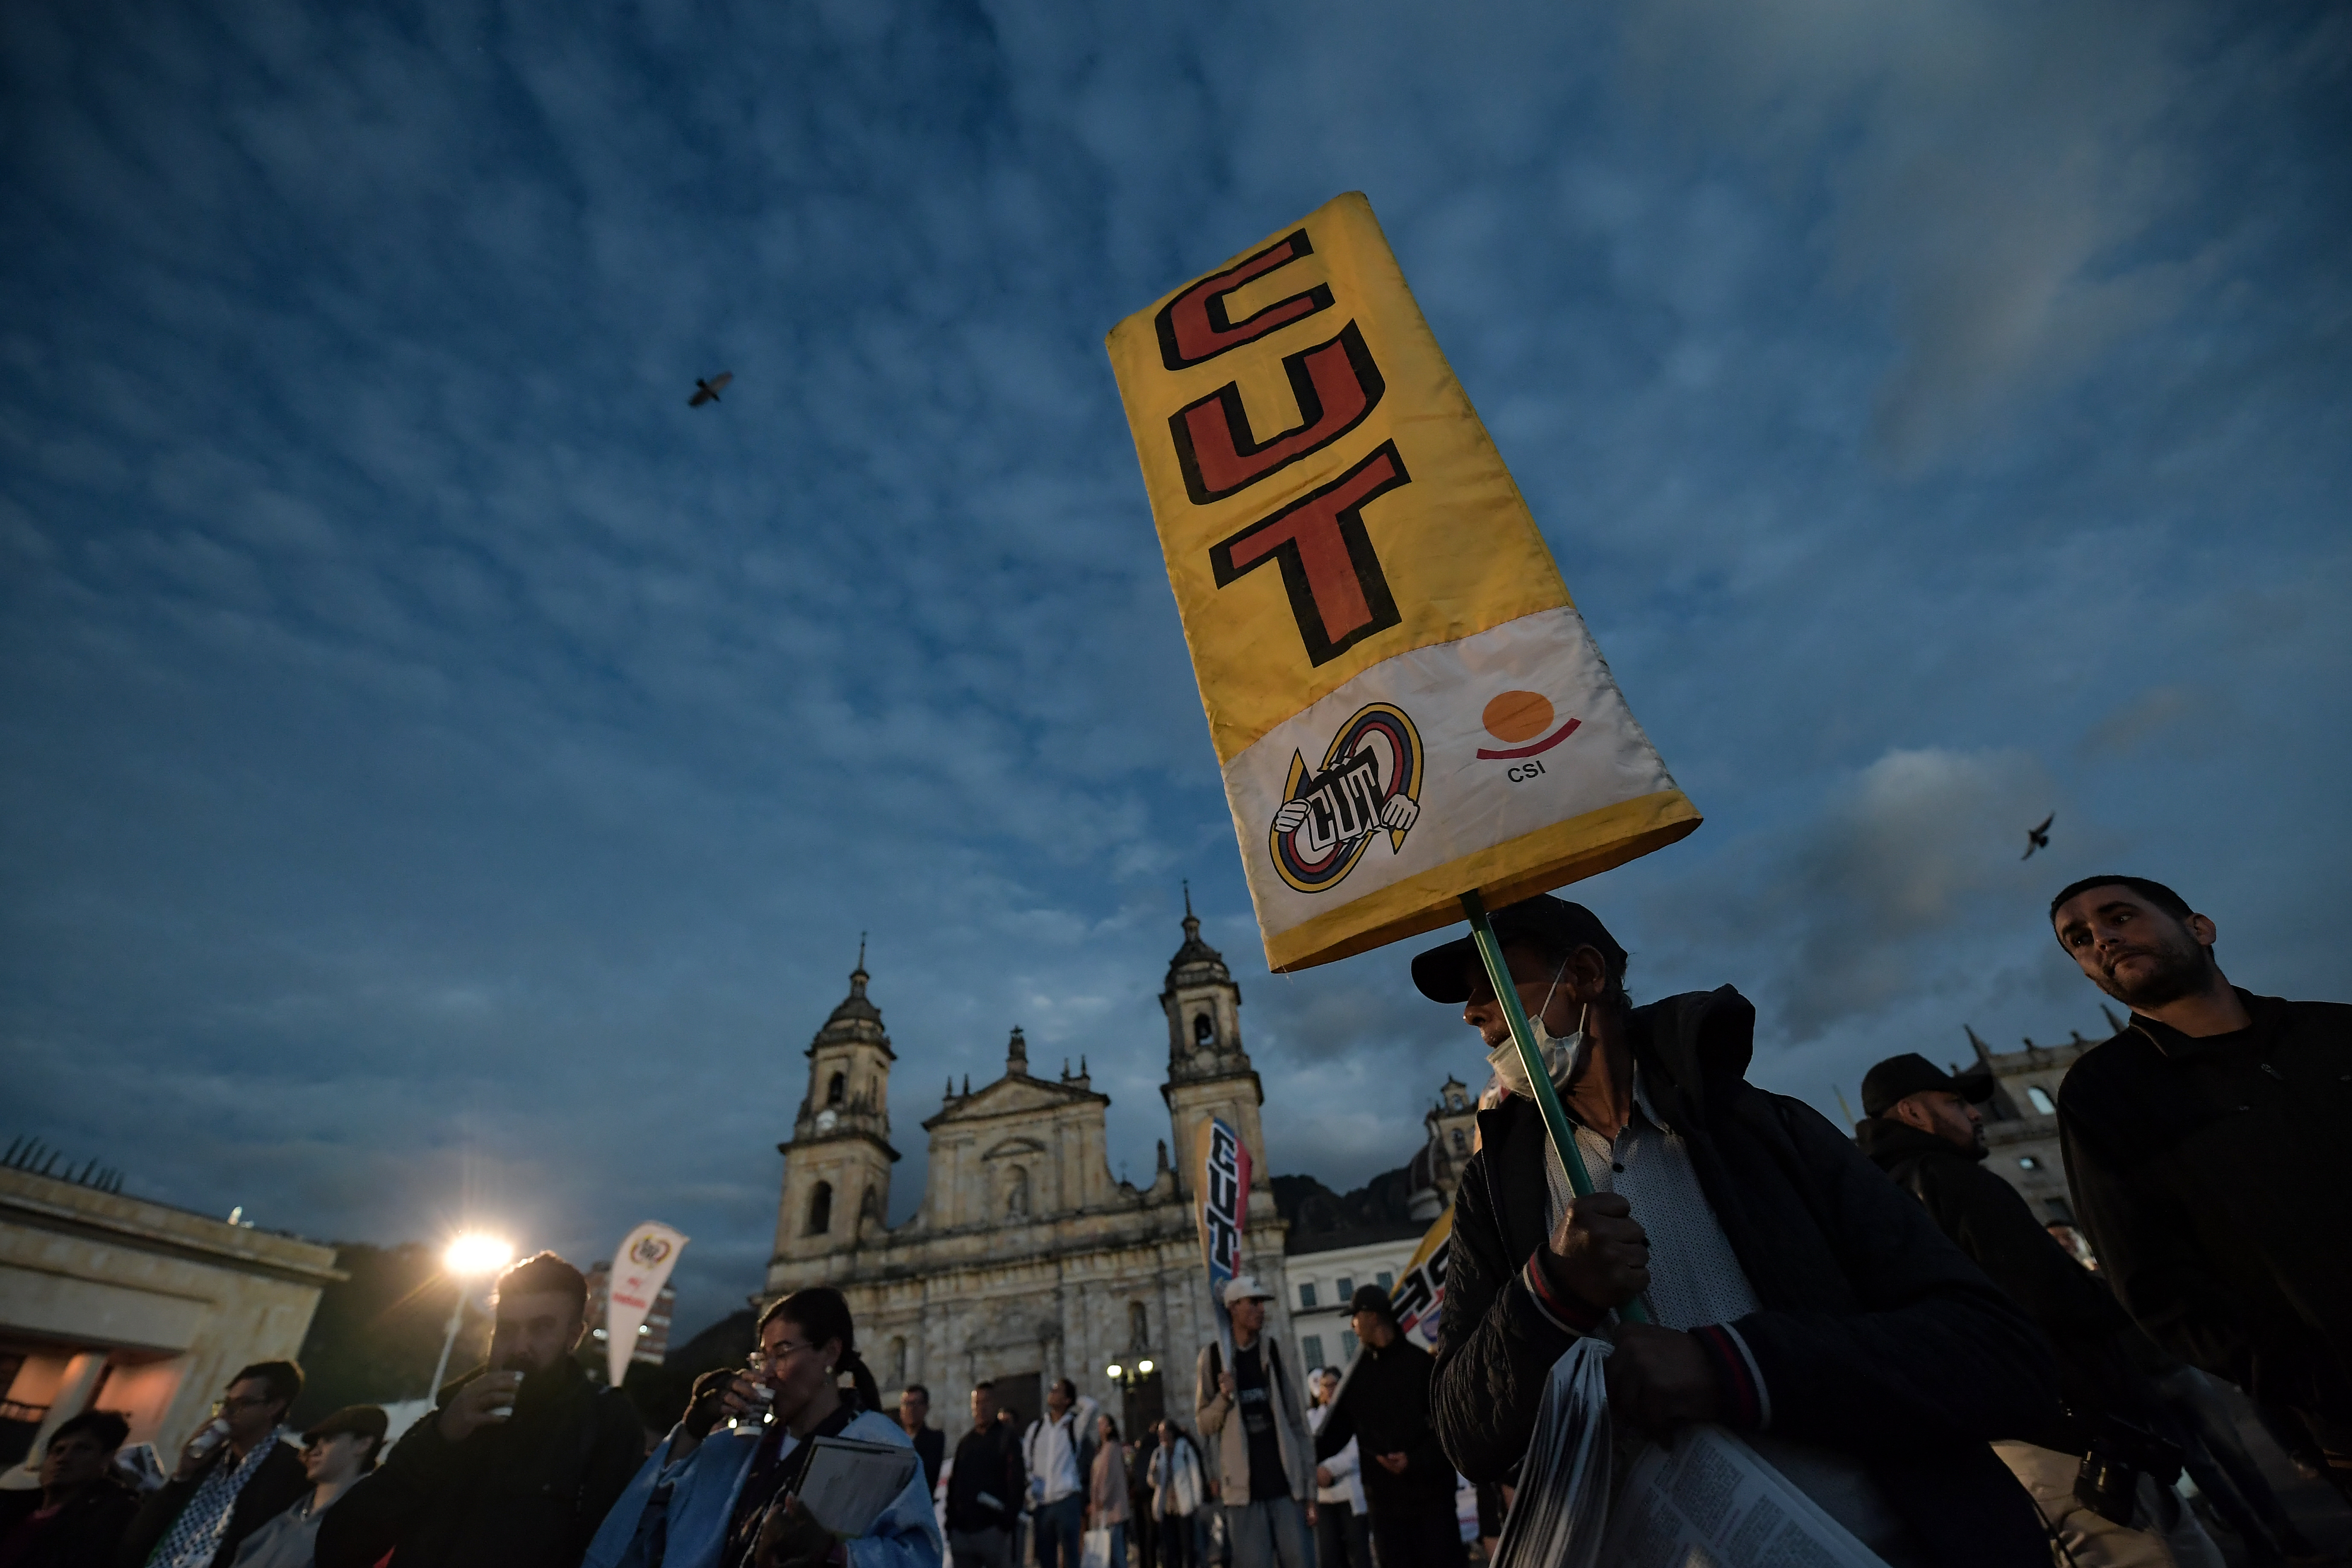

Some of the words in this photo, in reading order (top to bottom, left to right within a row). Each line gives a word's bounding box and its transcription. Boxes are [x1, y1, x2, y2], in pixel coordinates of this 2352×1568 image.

[1154, 228, 1411, 668] CUT
[1306, 758, 1383, 852] CUT
[1507, 760, 1546, 783] CSI
[1206, 1126, 1237, 1269] CUT
